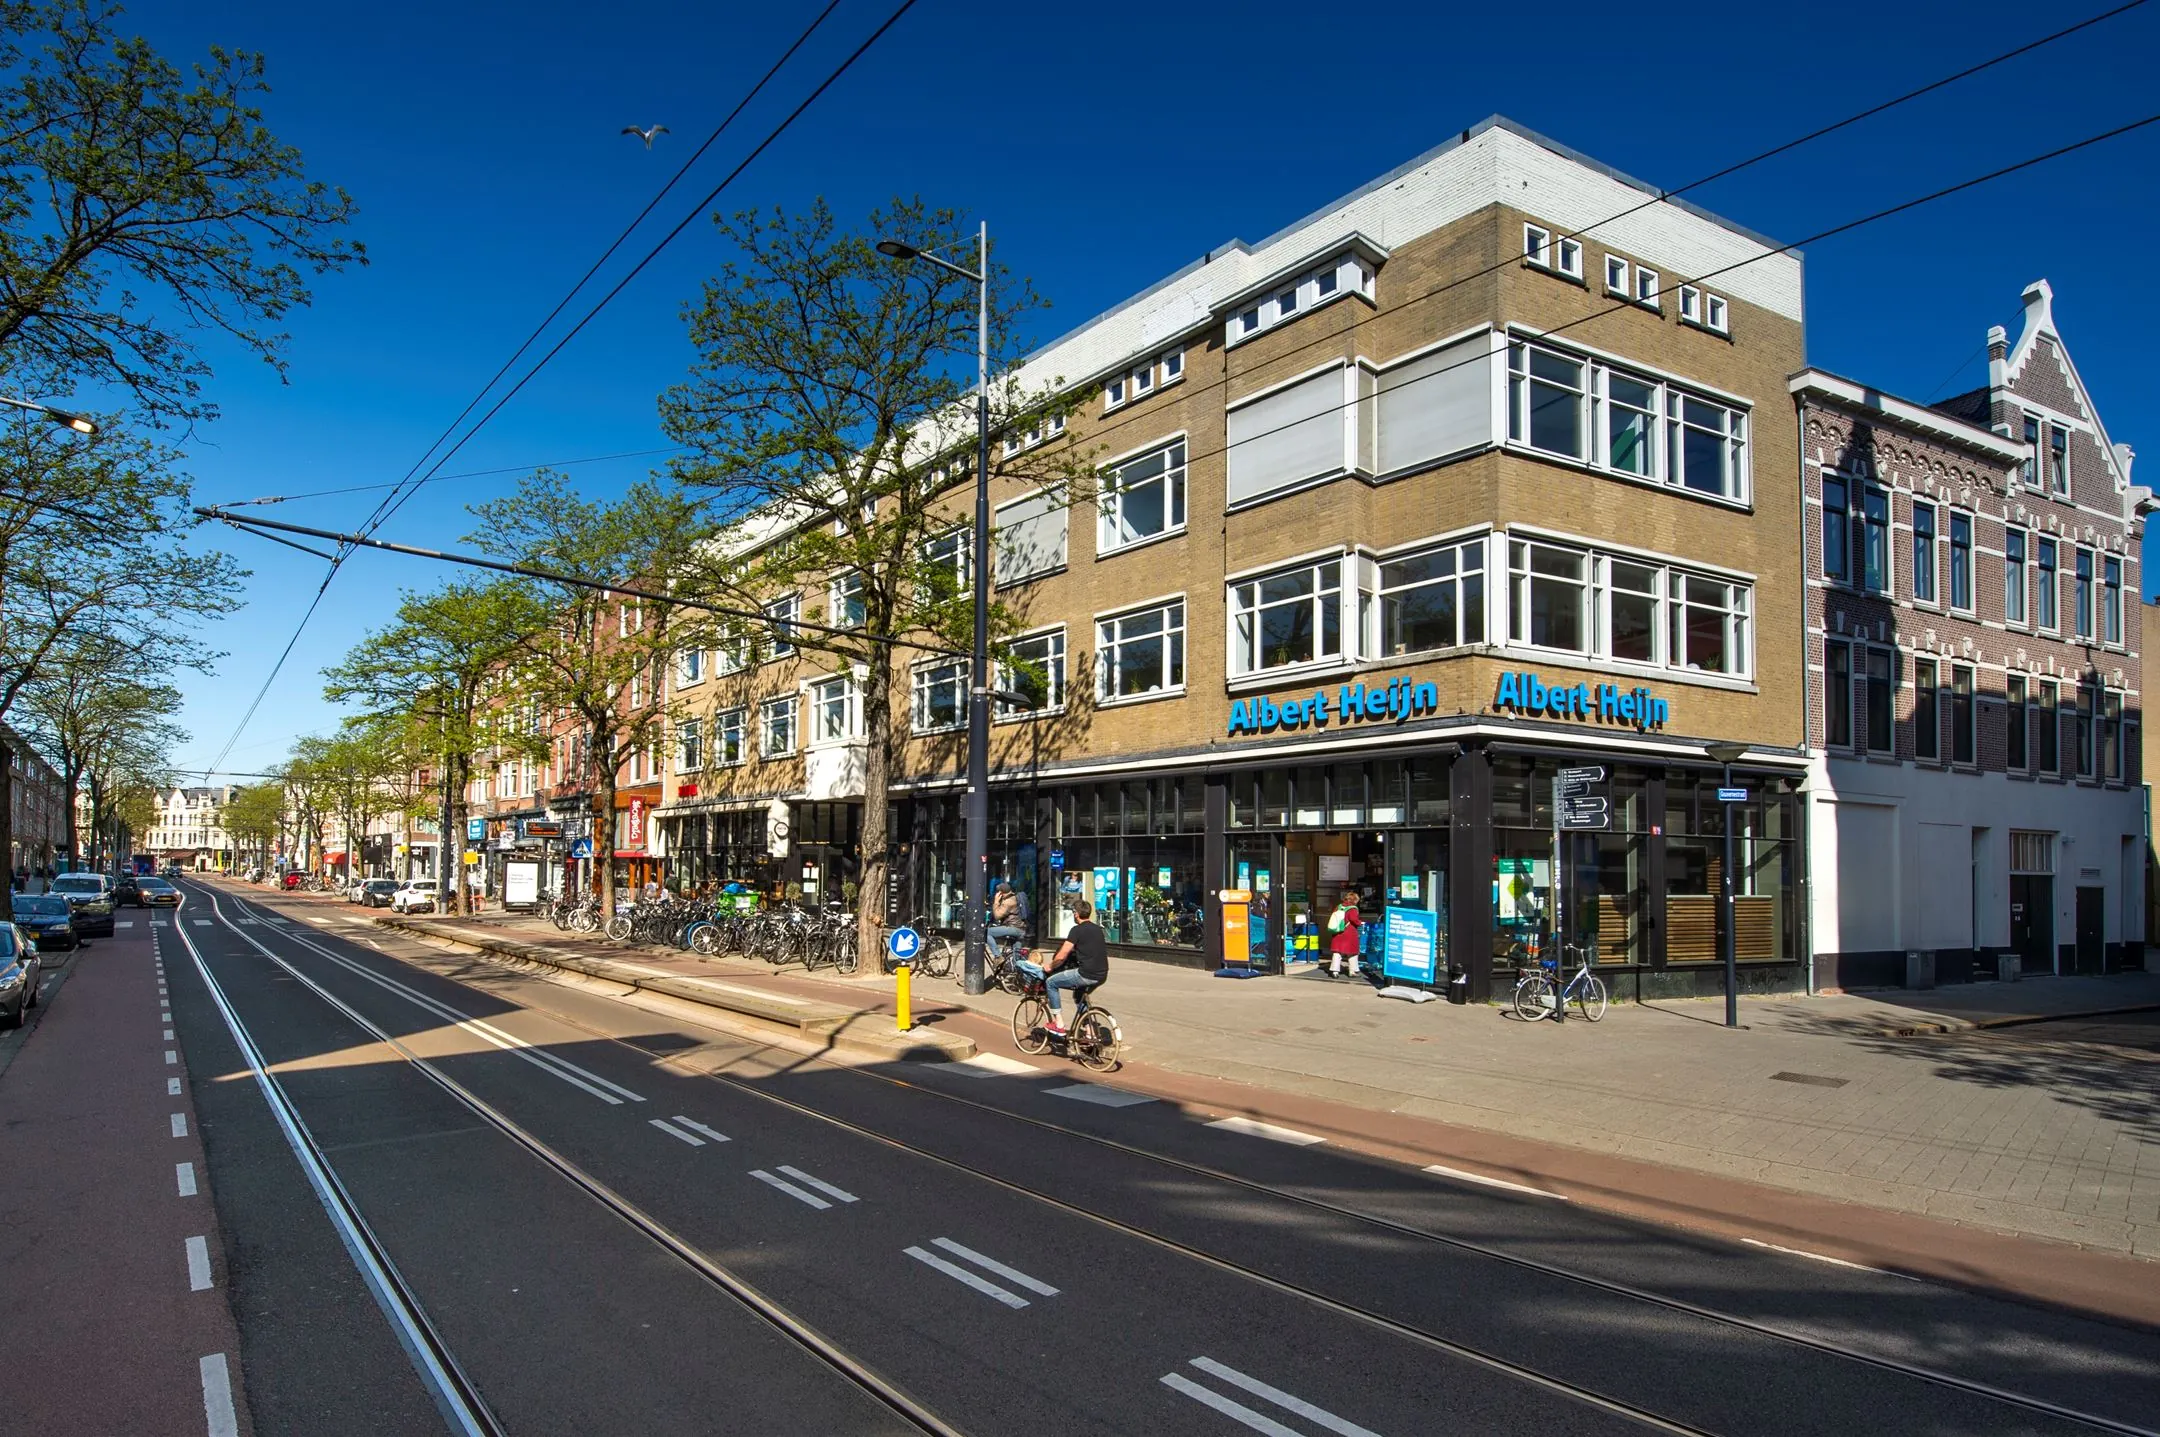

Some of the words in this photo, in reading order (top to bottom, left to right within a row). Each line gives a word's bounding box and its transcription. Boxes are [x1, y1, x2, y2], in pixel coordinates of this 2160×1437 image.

[1228, 691, 1328, 732] Albert
[1340, 676, 1438, 719] Heijn
[1496, 671, 1591, 715] Albert
[1599, 683, 1669, 728] Heijn
